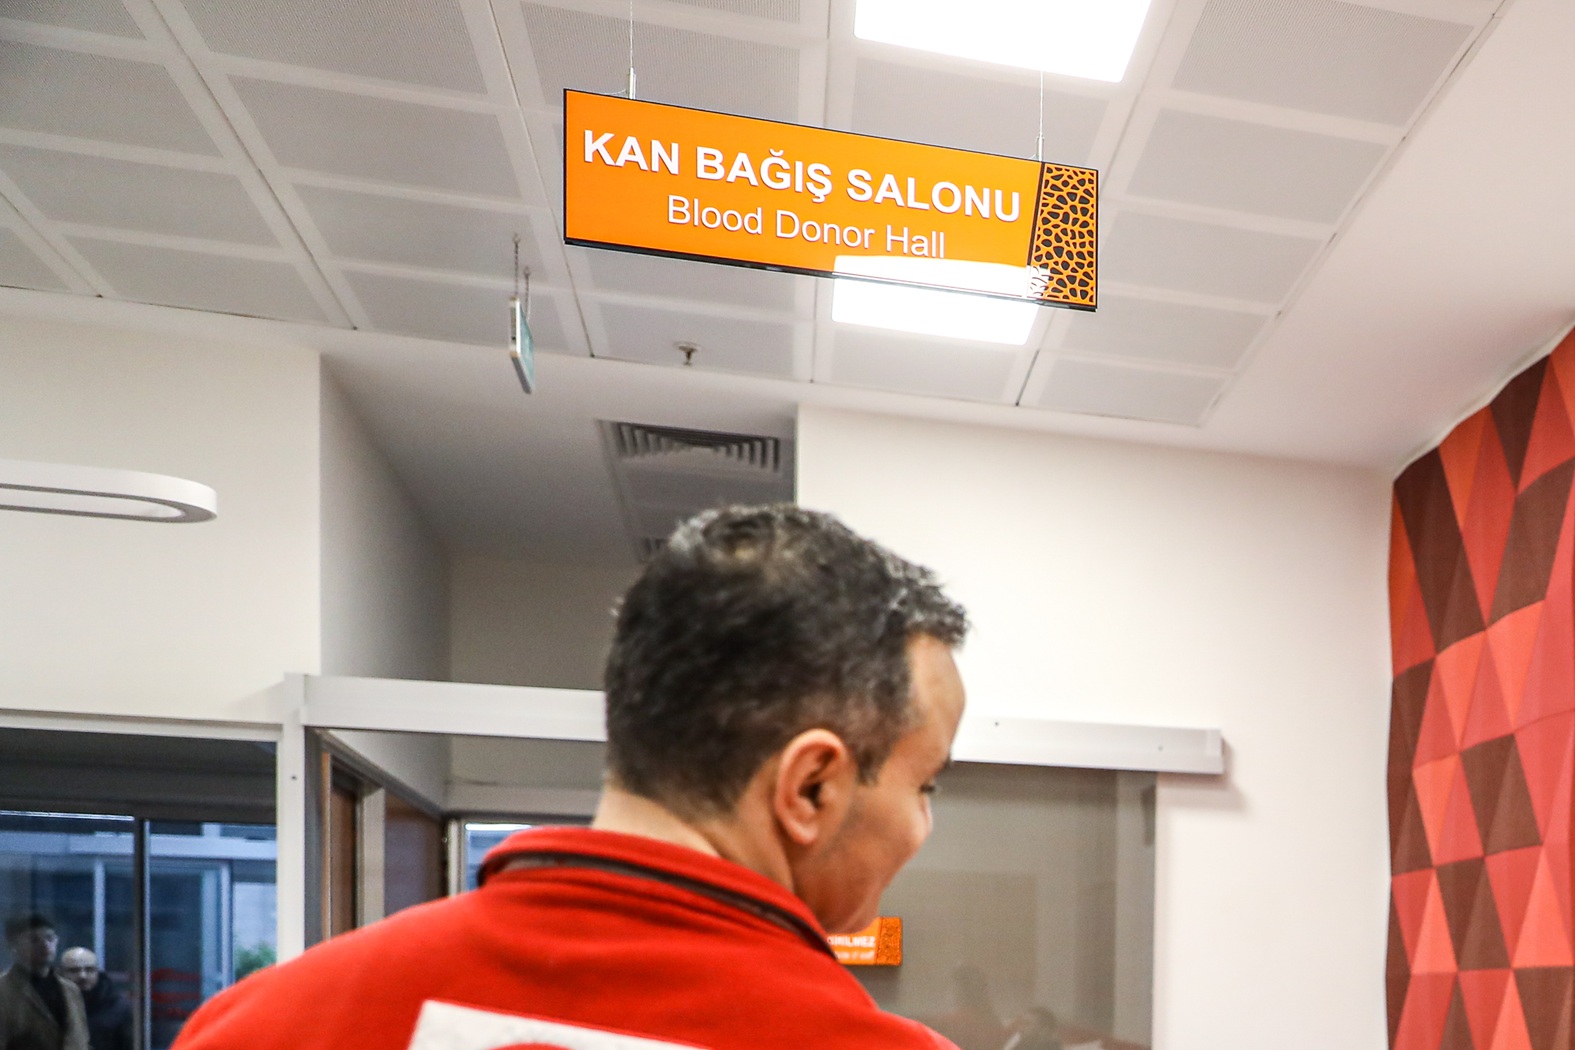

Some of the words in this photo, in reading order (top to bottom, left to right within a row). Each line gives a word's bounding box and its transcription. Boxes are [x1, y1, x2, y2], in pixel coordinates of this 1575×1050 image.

[583, 130, 680, 175] KAN
[695, 150, 833, 202] BAĞIŞ
[846, 168, 1020, 222] SALONU
[667, 195, 763, 234] Blood
[775, 210, 874, 249] Donor
[886, 226, 945, 259] Hall
